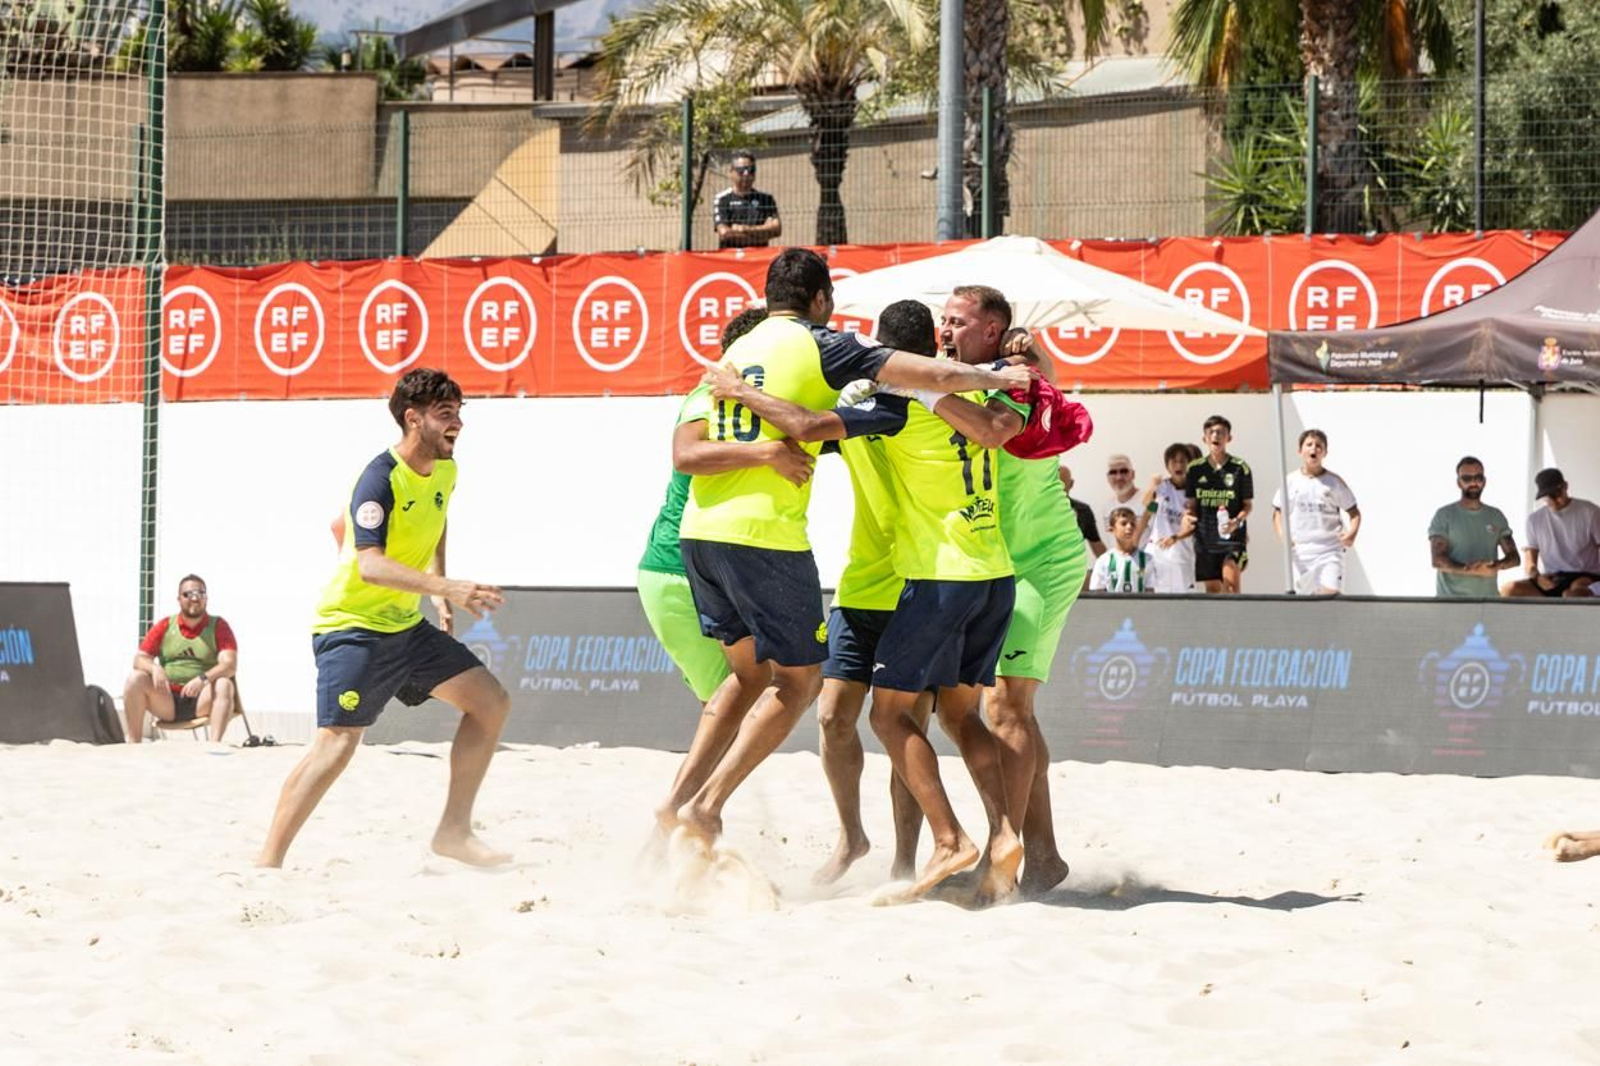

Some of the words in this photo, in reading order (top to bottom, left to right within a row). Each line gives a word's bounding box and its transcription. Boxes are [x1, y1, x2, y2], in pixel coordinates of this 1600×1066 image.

[700, 297, 744, 317] RF
[1184, 288, 1230, 309] RF
[1308, 286, 1357, 308] RF
[169, 308, 205, 328] RF
[272, 306, 308, 327] RF
[376, 303, 408, 323] RF
[482, 301, 519, 321] RF
[591, 301, 631, 320] RF
[70, 315, 106, 335] RF
[169, 334, 205, 354] EF
[271, 332, 308, 352] EF
[376, 329, 408, 351] EF
[481, 327, 520, 348] EF
[591, 327, 631, 348] EF
[70, 340, 106, 359] EF
[525, 634, 571, 672] COPA
[1176, 647, 1228, 686] COPA
[1231, 644, 1352, 689] FEDERACIÓN
[1532, 653, 1587, 695] COPA
[588, 678, 640, 692] PLAYA
[1171, 688, 1244, 707] FÚTBOL
[1251, 694, 1309, 708] PLAYA
